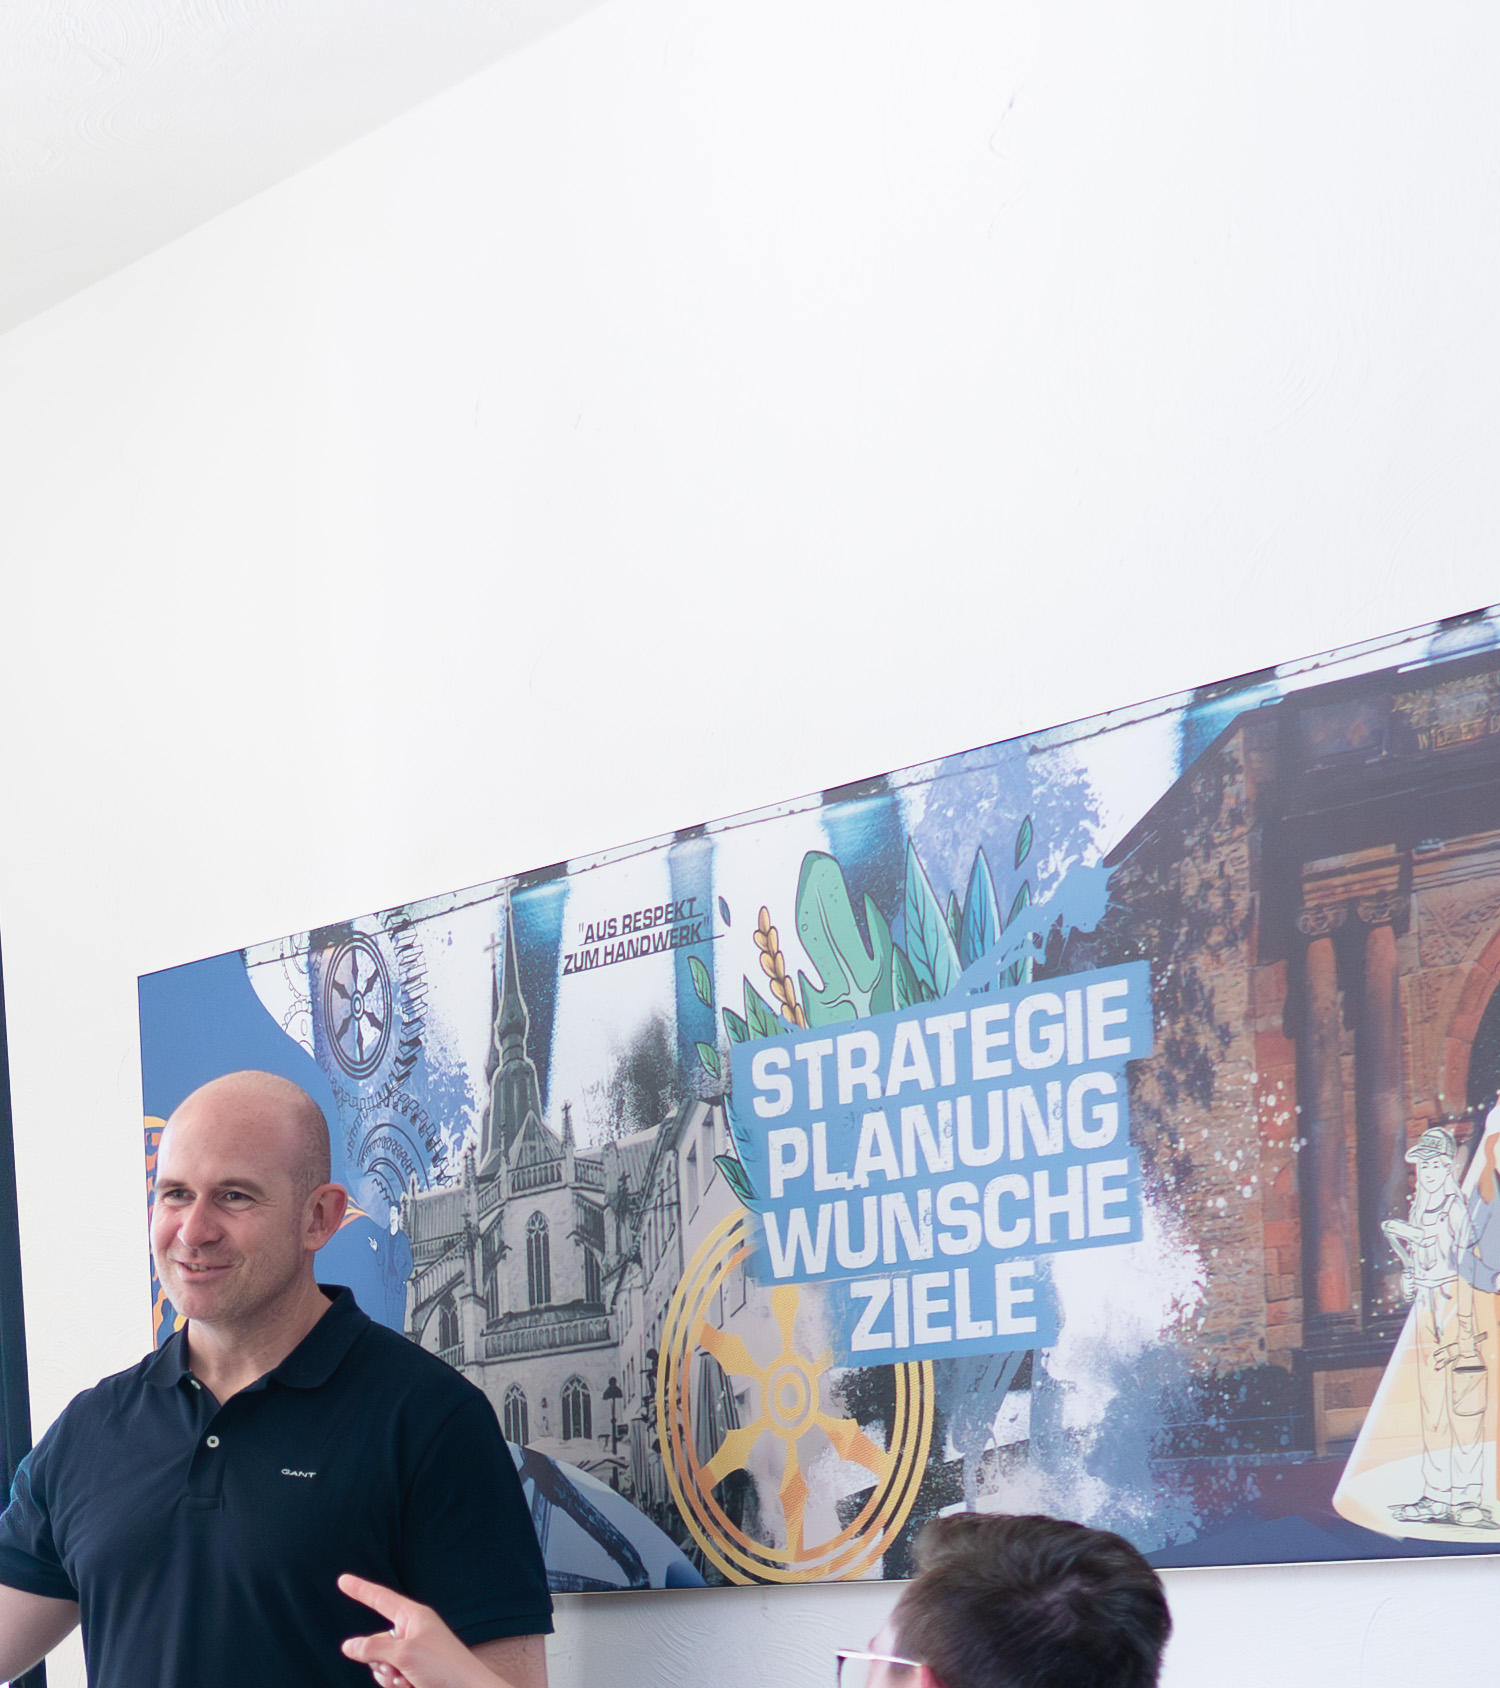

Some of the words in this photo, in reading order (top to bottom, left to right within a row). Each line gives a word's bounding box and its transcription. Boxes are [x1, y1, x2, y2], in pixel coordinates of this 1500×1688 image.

[622, 897, 697, 936] RESPEKT
[563, 947, 600, 975] ZUM
[751, 978, 1131, 1118] STRATEGIE
[767, 1071, 1119, 1199] PLANUNG
[850, 1261, 1037, 1353] ZIELE
[281, 1468, 317, 1478] GANT
